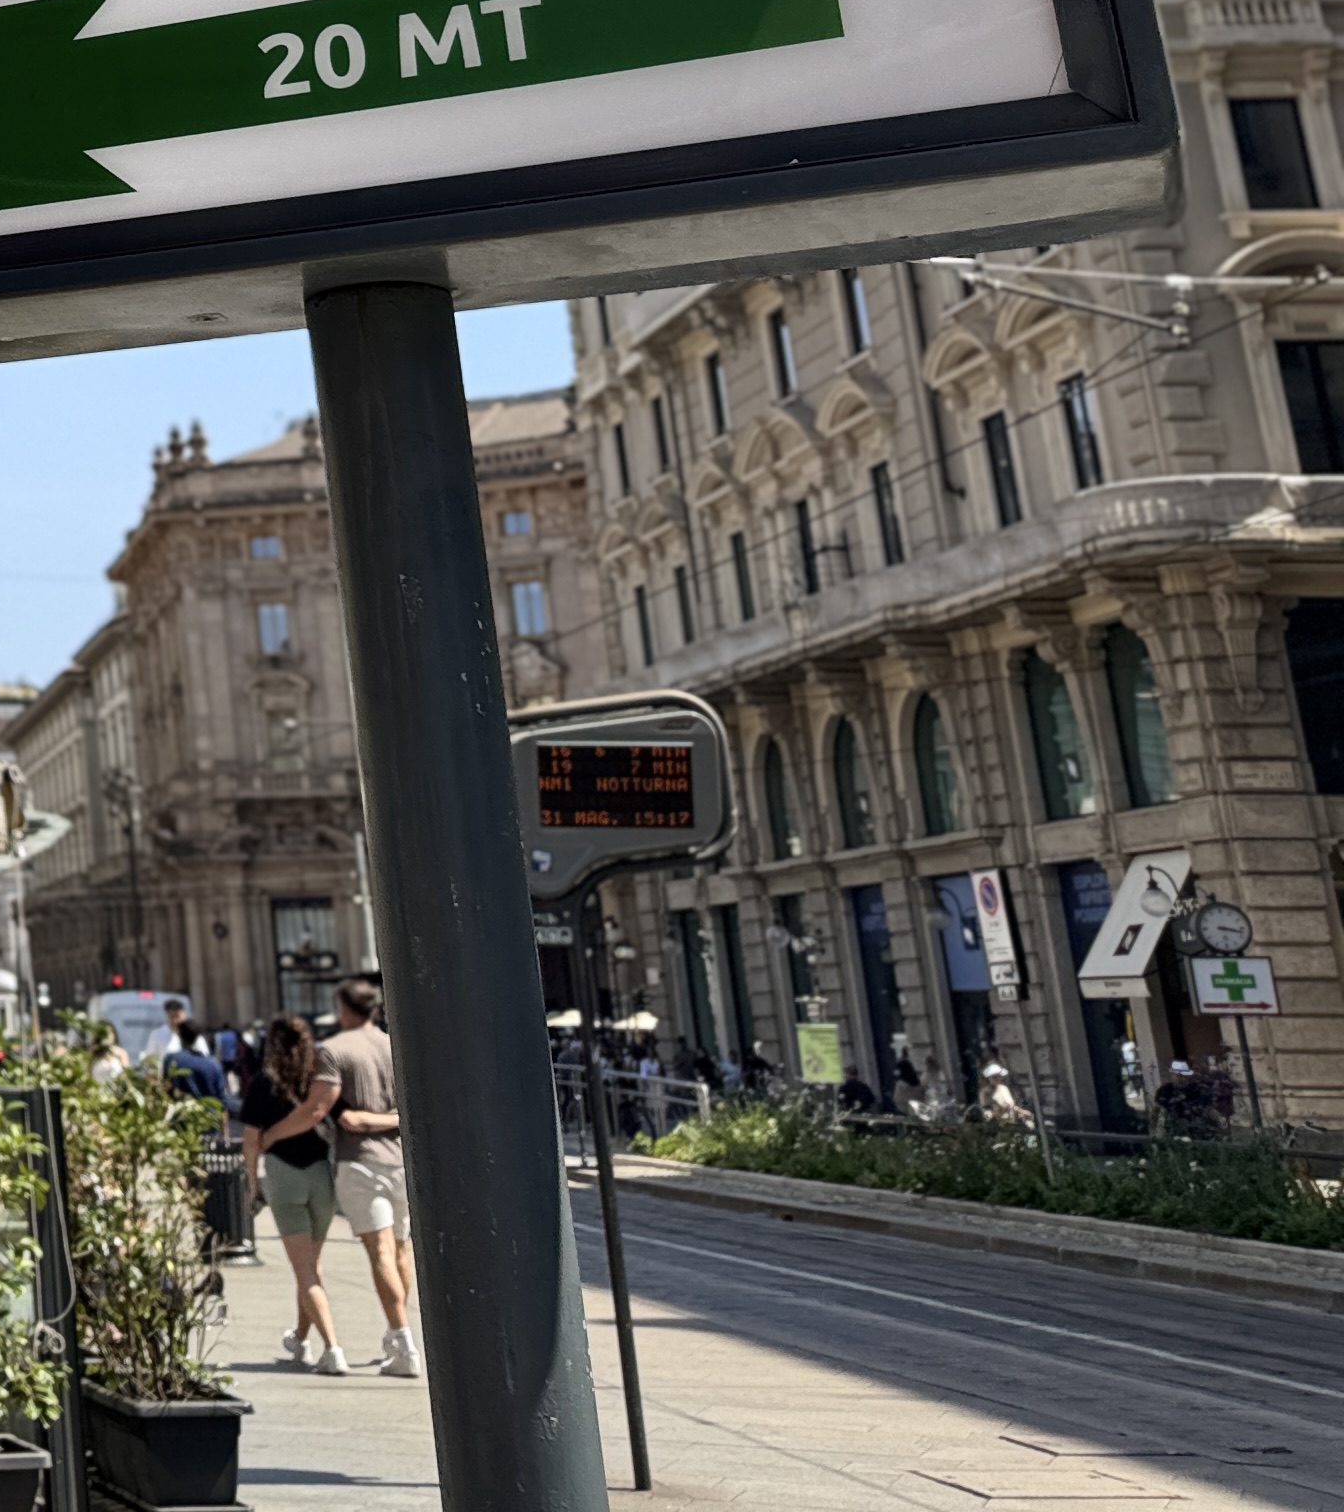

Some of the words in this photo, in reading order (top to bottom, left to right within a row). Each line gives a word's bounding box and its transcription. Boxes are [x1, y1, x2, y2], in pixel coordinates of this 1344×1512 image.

[257, 23, 366, 99] 20
[652, 747, 687, 757] MIN
[551, 760, 573, 774] 19
[631, 760, 641, 774] 7
[653, 760, 688, 774] MIN
[538, 777, 572, 792] NM1
[596, 777, 689, 792] NOTTURNA
[541, 810, 562, 825] 31
[634, 811, 690, 826] 15:17
